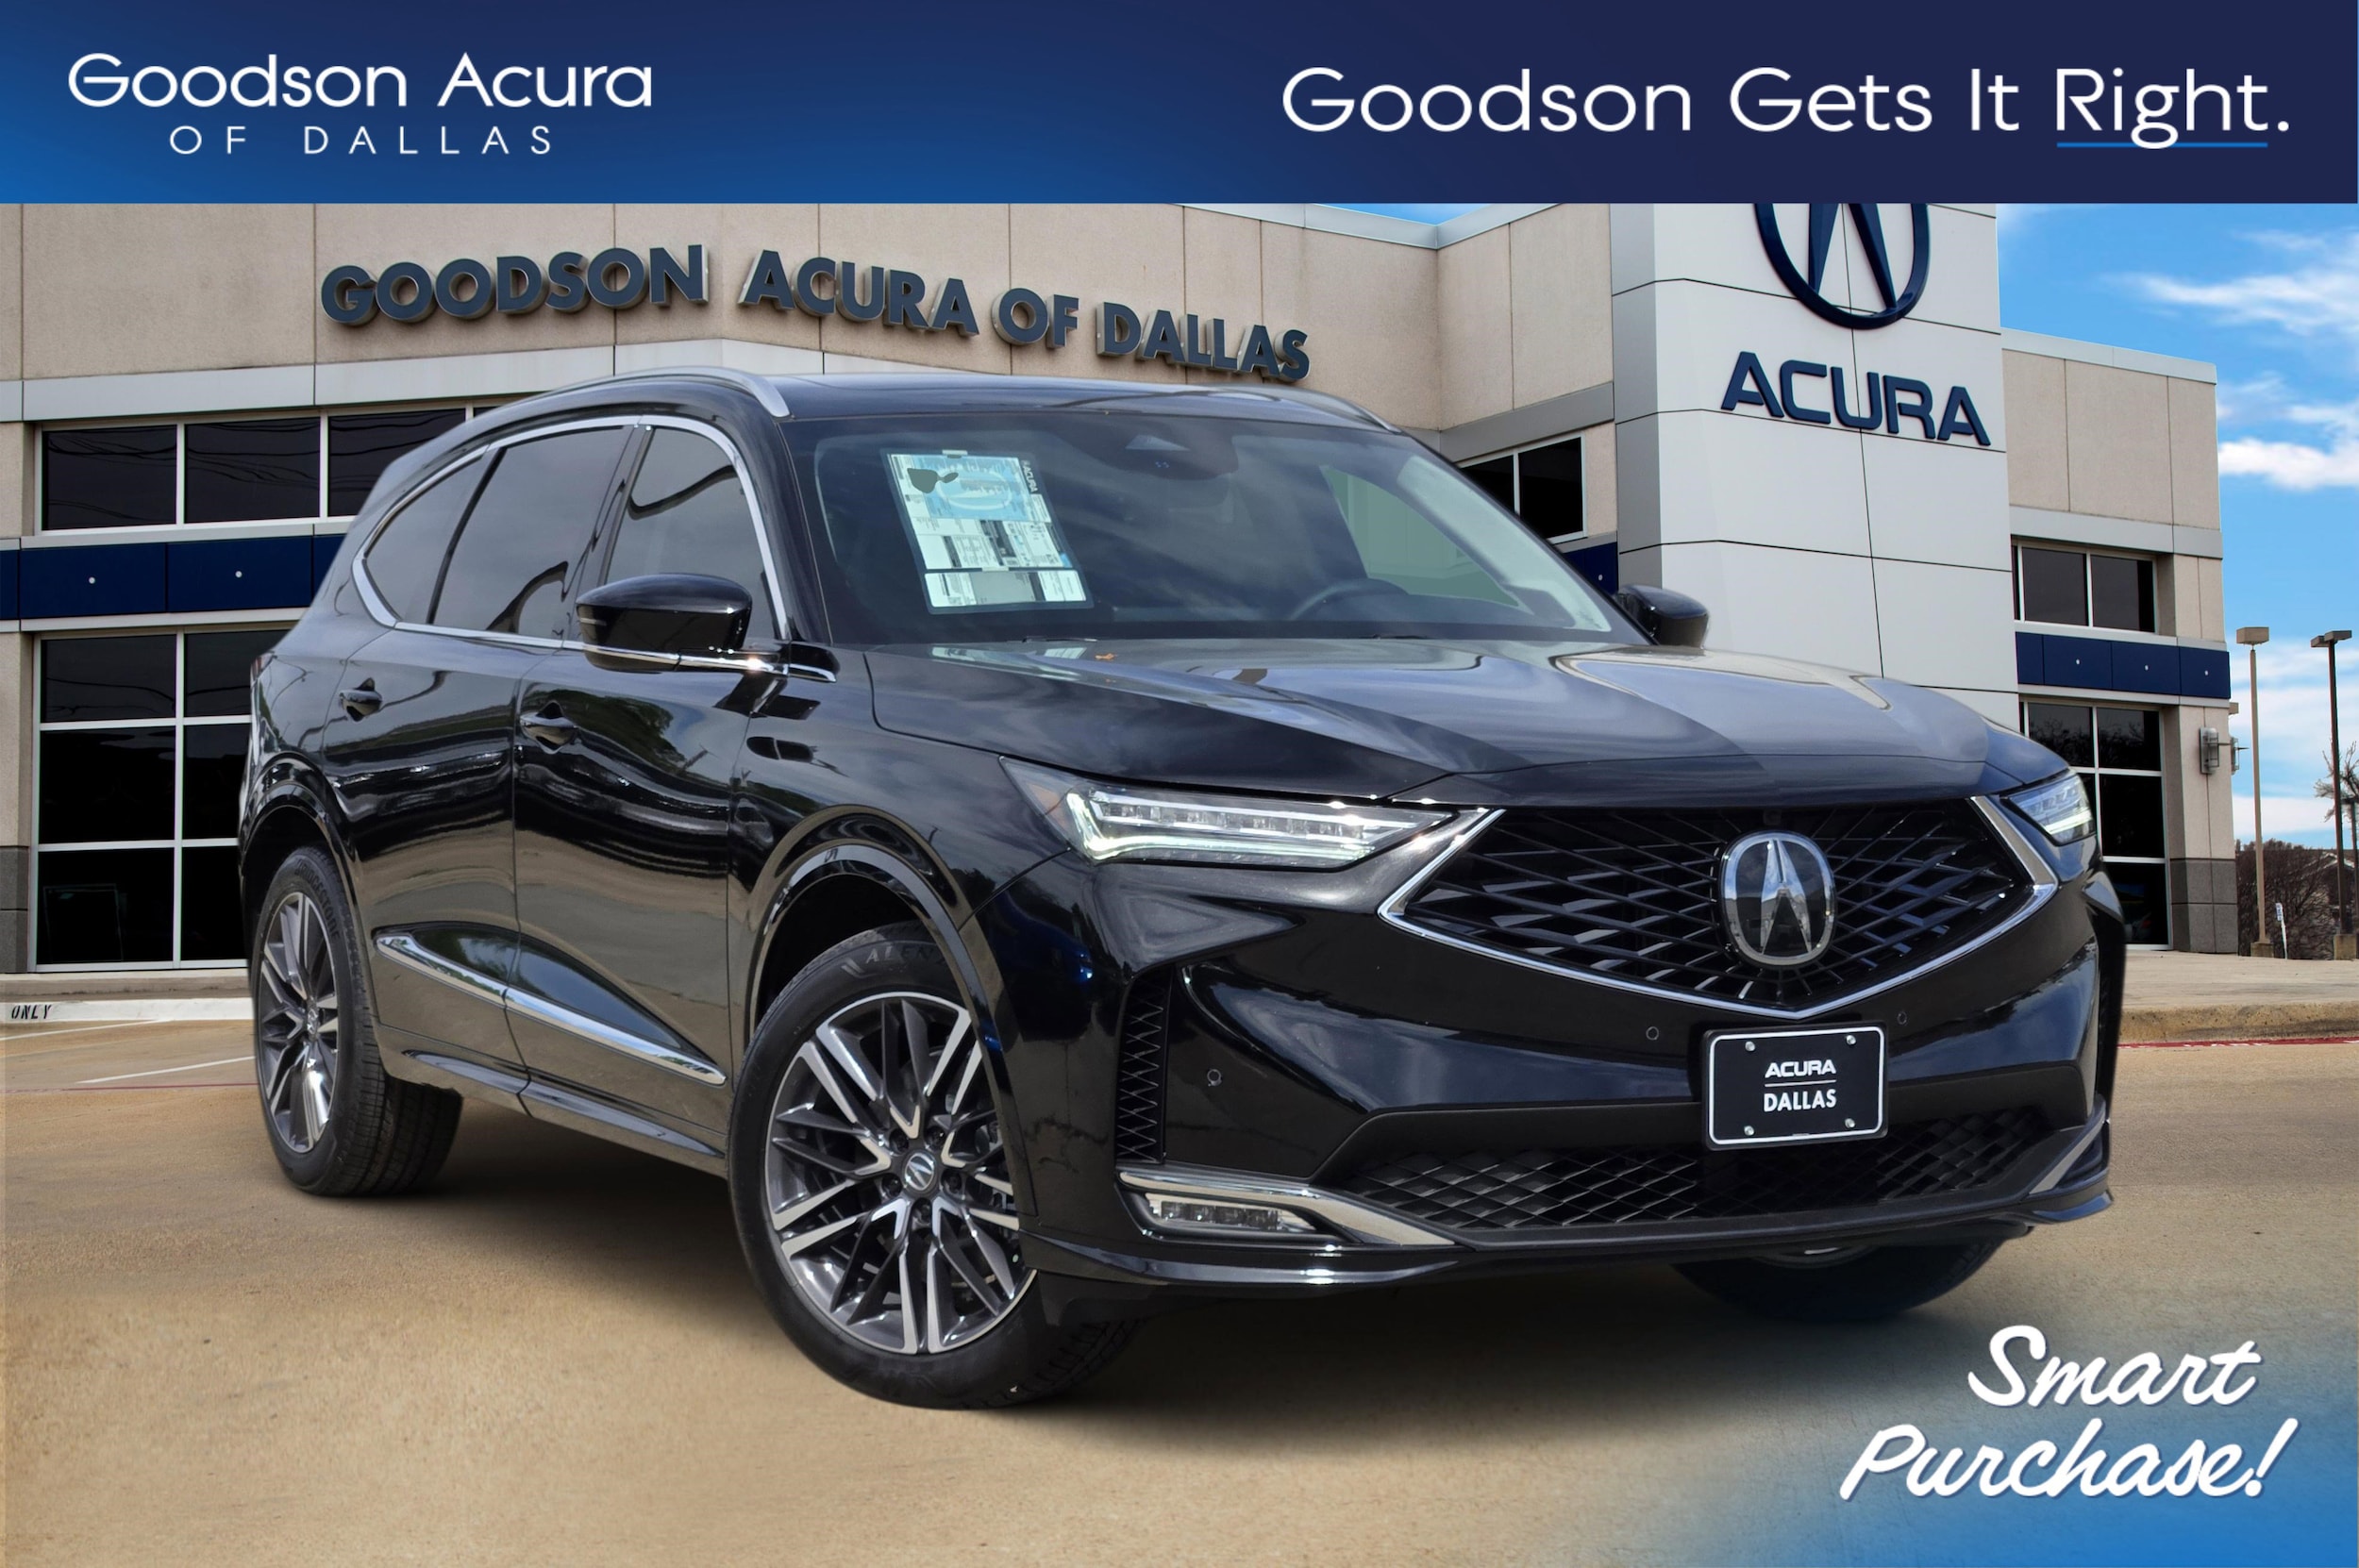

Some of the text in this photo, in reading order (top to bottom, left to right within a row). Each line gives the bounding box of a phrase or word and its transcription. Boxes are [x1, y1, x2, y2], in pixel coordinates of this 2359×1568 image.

[321, 244, 1311, 382] GOODSON ACURA OF DALLAS
[1721, 350, 1991, 446] ACURA
[1023, 465, 1038, 493] ACURA
[294, 859, 340, 939] BRIDGESTONE
[11, 1005, 52, 1020] ONLY
[1765, 1059, 1836, 1078] ACURA
[1764, 1088, 1837, 1112] DALLAS
